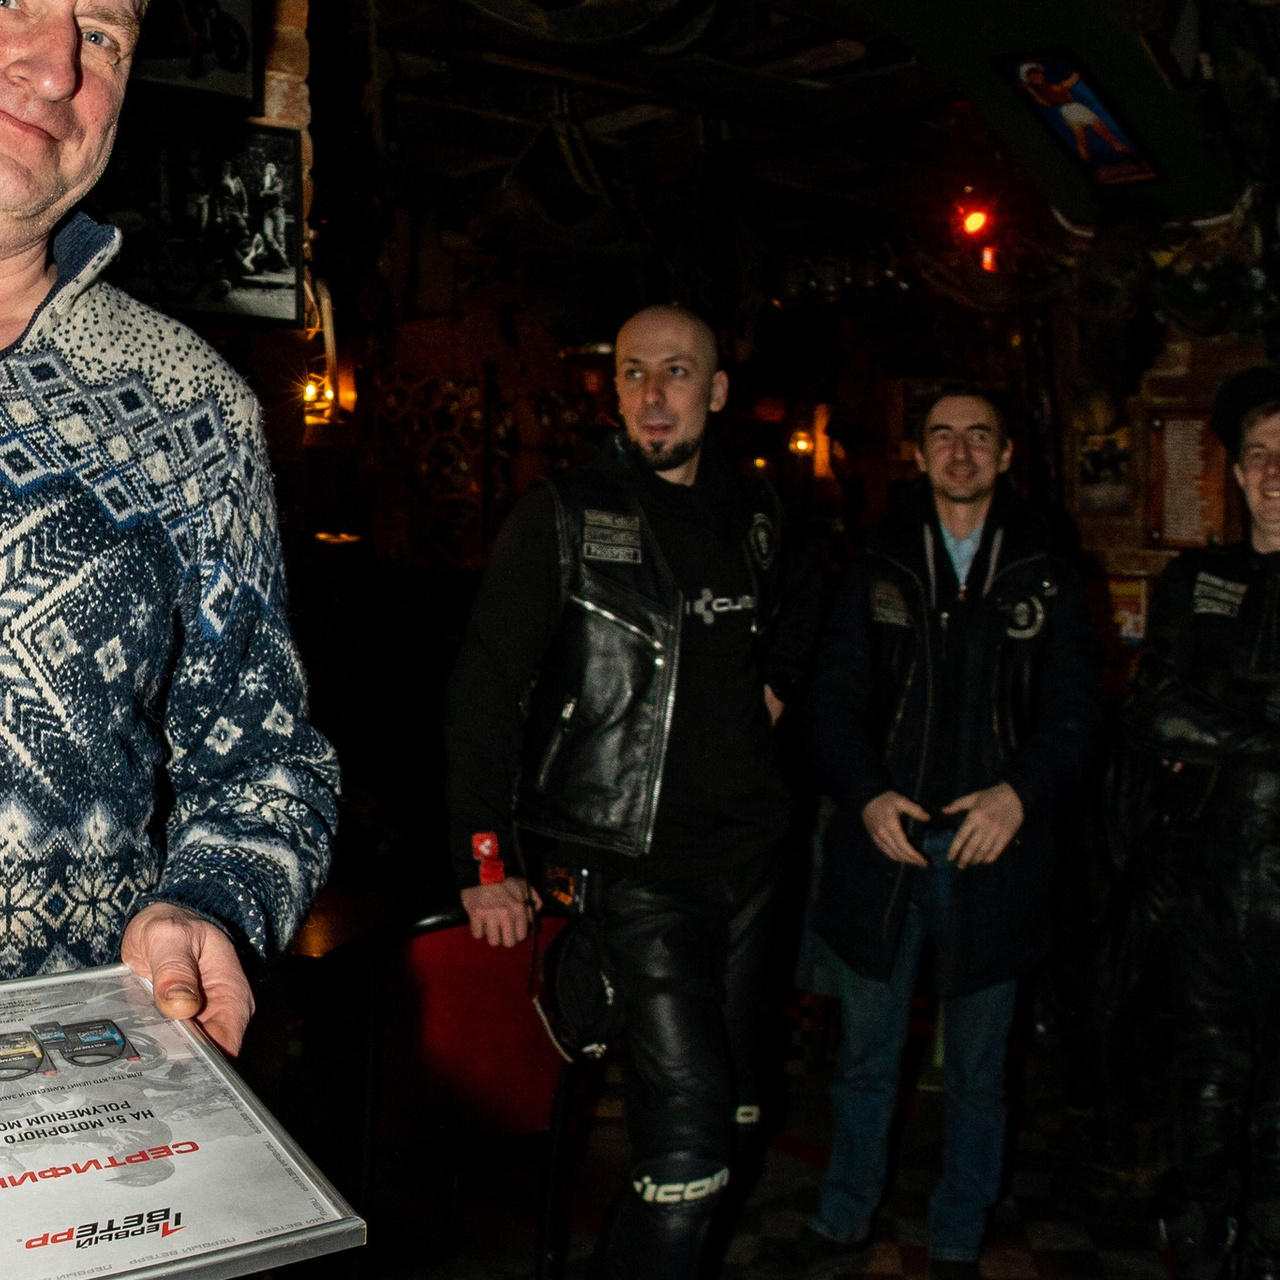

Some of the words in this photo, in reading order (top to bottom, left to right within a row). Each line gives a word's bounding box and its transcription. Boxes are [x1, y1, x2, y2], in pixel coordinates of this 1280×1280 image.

[25, 1100, 131, 1126] POLYMERIUM
[128, 1109, 155, 1121] НА
[2, 1118, 105, 1144] МОТОРНОГО
[24, 1207, 172, 1249] ВЕТЕРР
